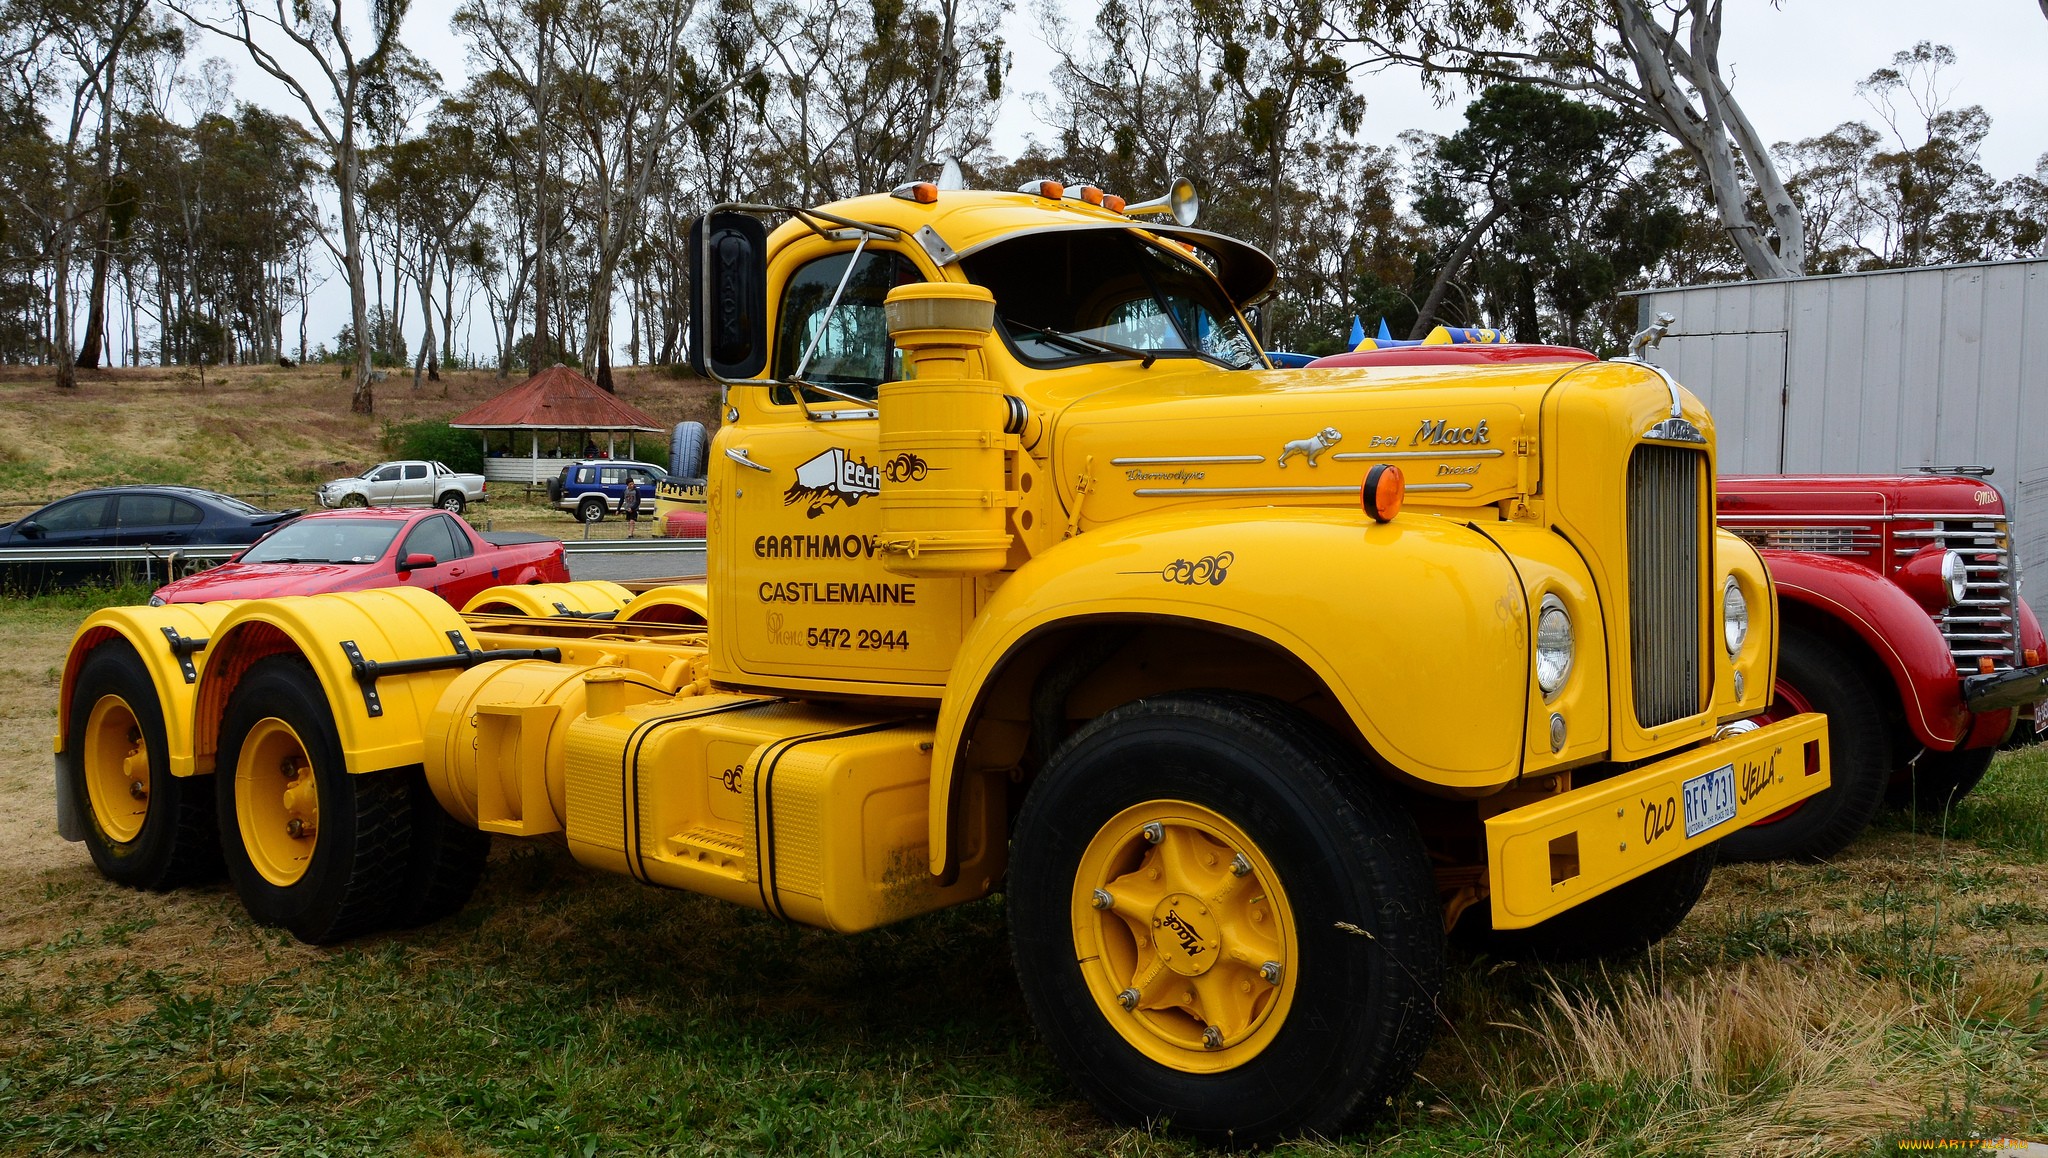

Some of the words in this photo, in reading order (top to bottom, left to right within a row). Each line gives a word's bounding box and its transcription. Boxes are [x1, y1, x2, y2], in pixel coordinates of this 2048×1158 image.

[1409, 418, 1490, 446] Mack
[1125, 468, 1205, 485] Thermodyne
[1436, 463, 1481, 477] Diesel
[1974, 490, 1998, 506] Miss
[759, 582, 916, 604] CASTLEMAINE
[765, 609, 804, 646] Phone
[807, 627, 851, 648] 5472
[857, 629, 909, 650] 2944
[1685, 783, 1708, 823] RFG
[1714, 773, 1733, 811] 231
[1163, 909, 1206, 957] Mack
